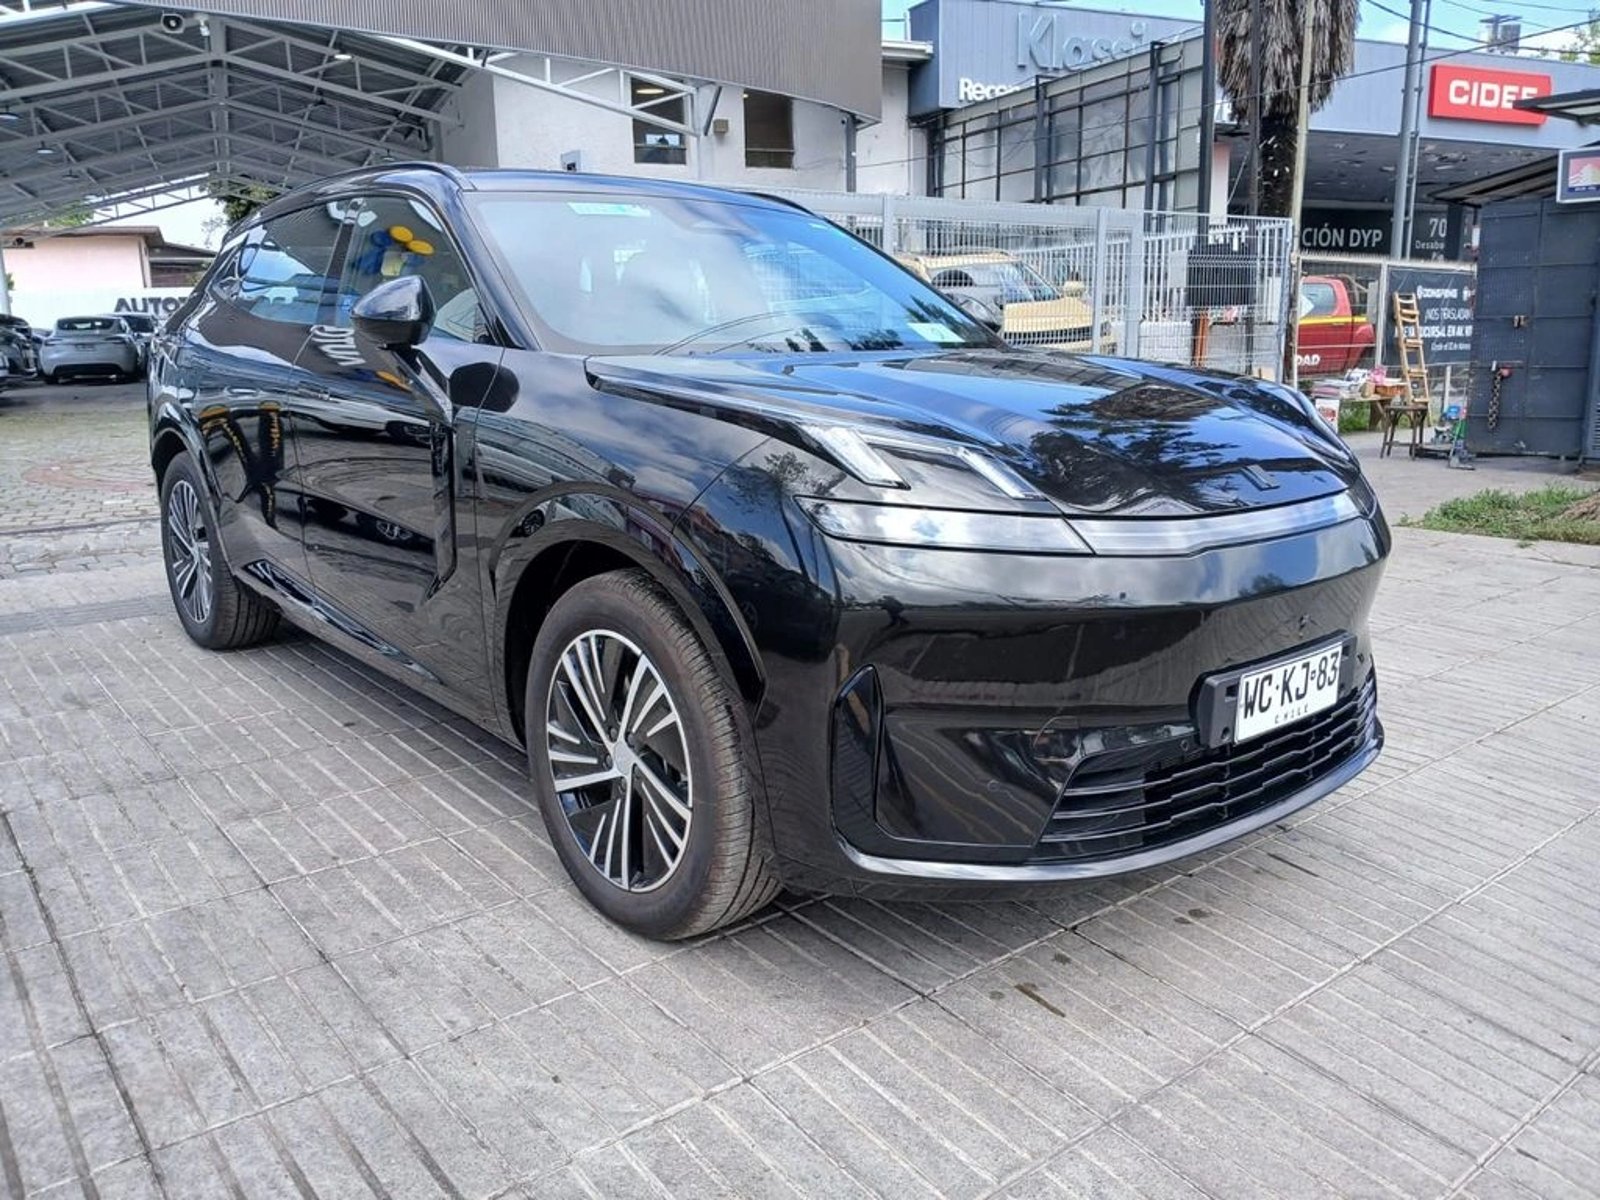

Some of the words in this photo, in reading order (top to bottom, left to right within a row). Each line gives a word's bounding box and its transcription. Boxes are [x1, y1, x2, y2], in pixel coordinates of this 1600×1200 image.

[1302, 222, 1345, 247] CIÓN
[1349, 229, 1383, 247] DYP
[1429, 218, 1447, 238] 70
[1274, 704, 1309, 725] CHILE
